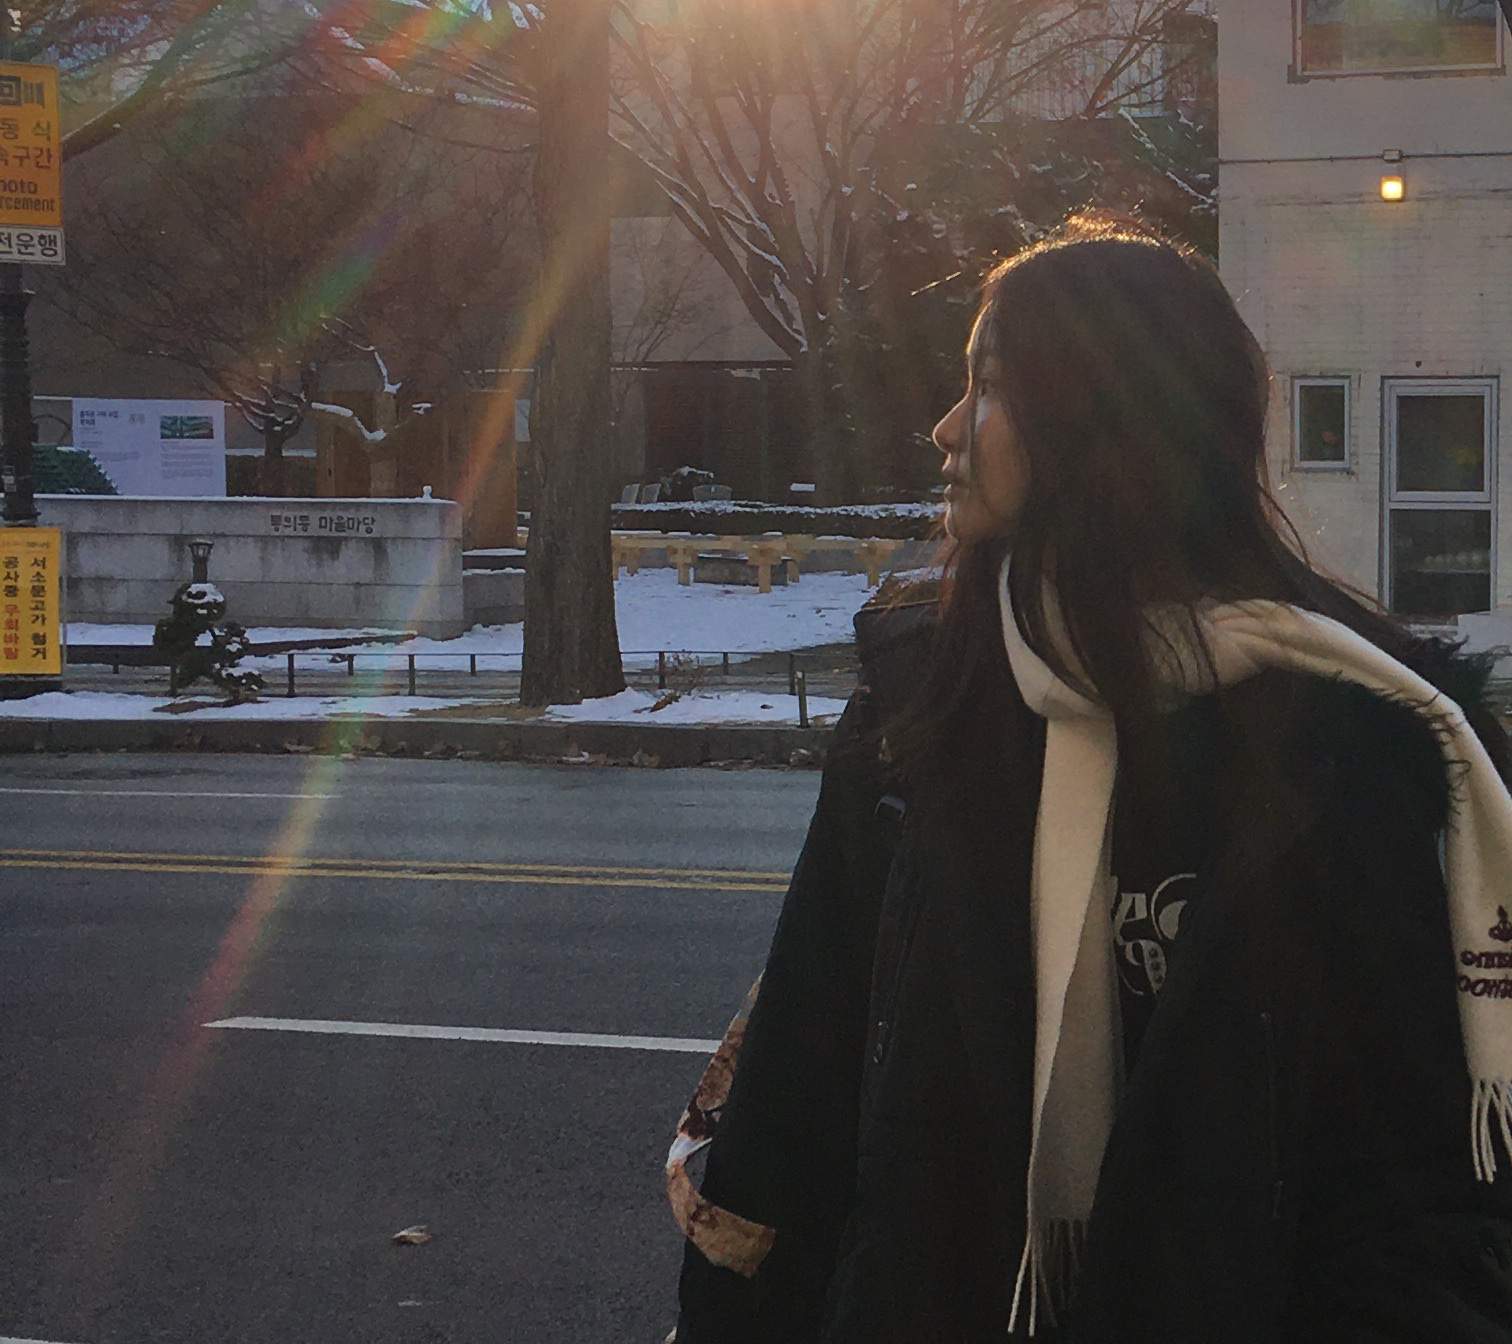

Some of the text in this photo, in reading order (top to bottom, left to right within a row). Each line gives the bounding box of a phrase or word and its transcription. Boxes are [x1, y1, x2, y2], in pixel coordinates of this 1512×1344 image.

[270, 514, 376, 535] 통의동 마을마당
[2, 556, 20, 597] 공사중
